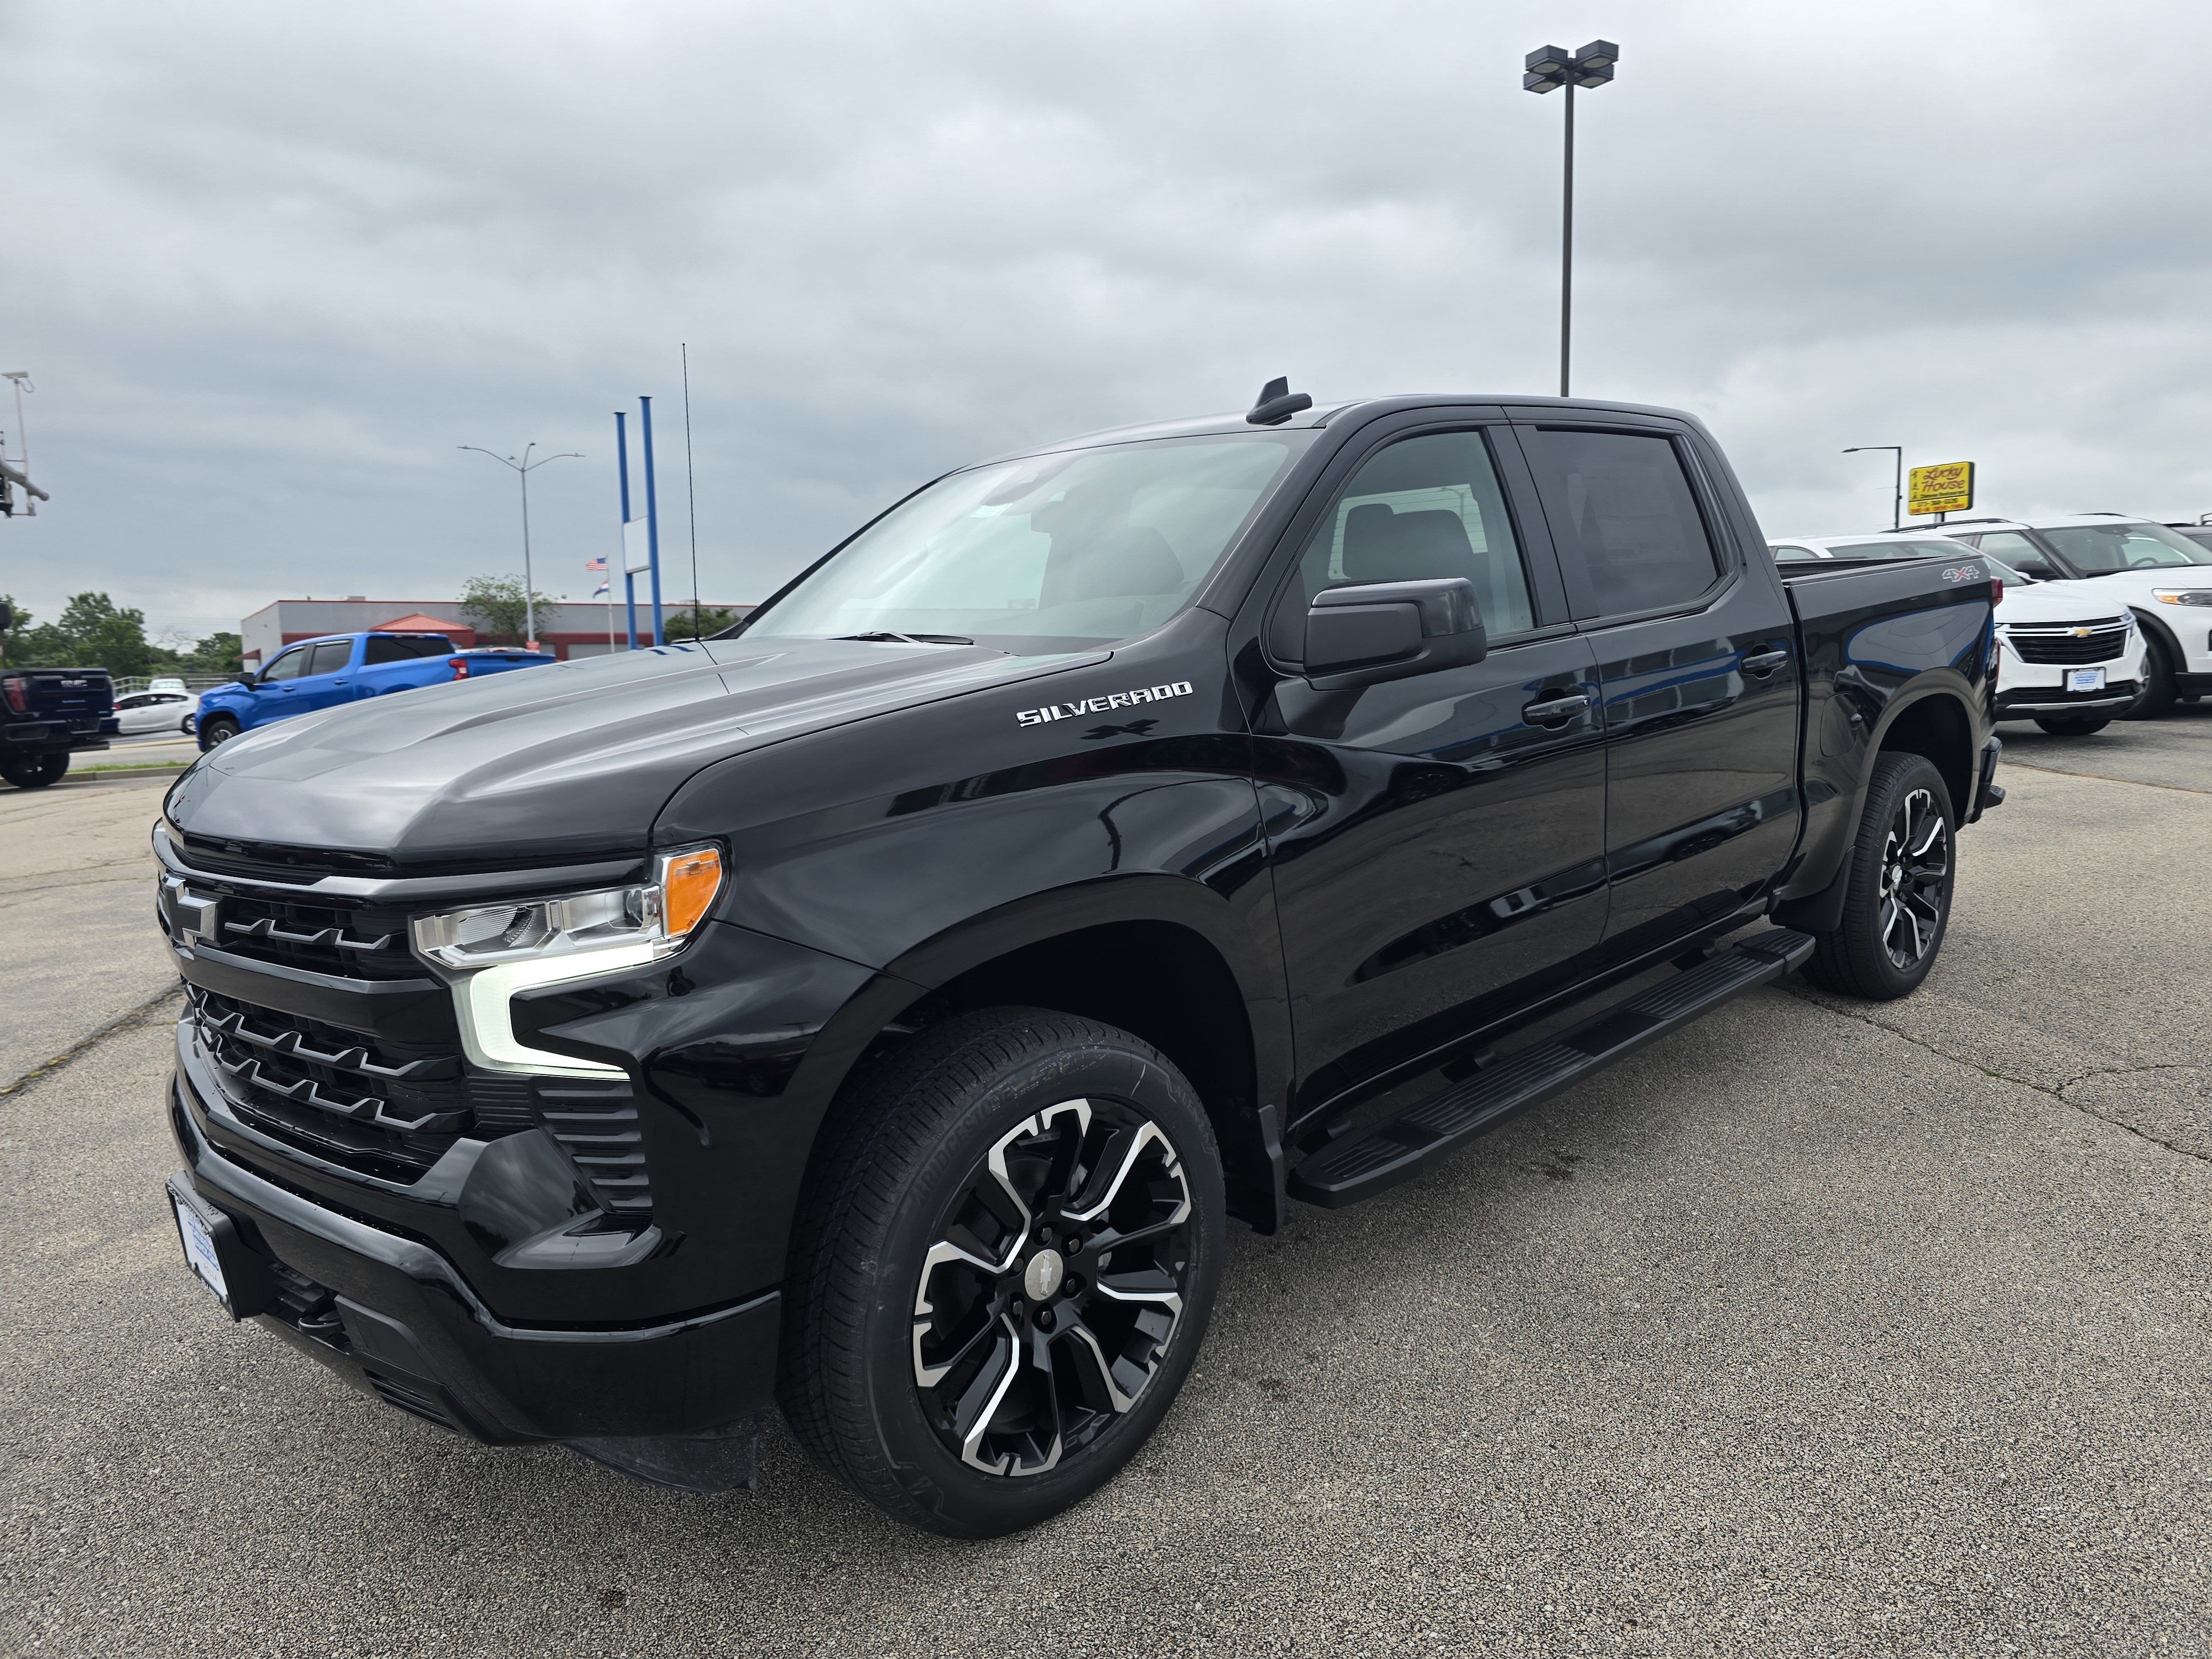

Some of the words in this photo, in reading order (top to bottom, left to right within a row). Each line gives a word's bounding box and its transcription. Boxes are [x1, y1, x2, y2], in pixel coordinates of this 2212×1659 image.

[1922, 467, 1964, 480] Lucky
[1921, 480, 1965, 493] House
[1015, 681, 1193, 728] SILVERADO
